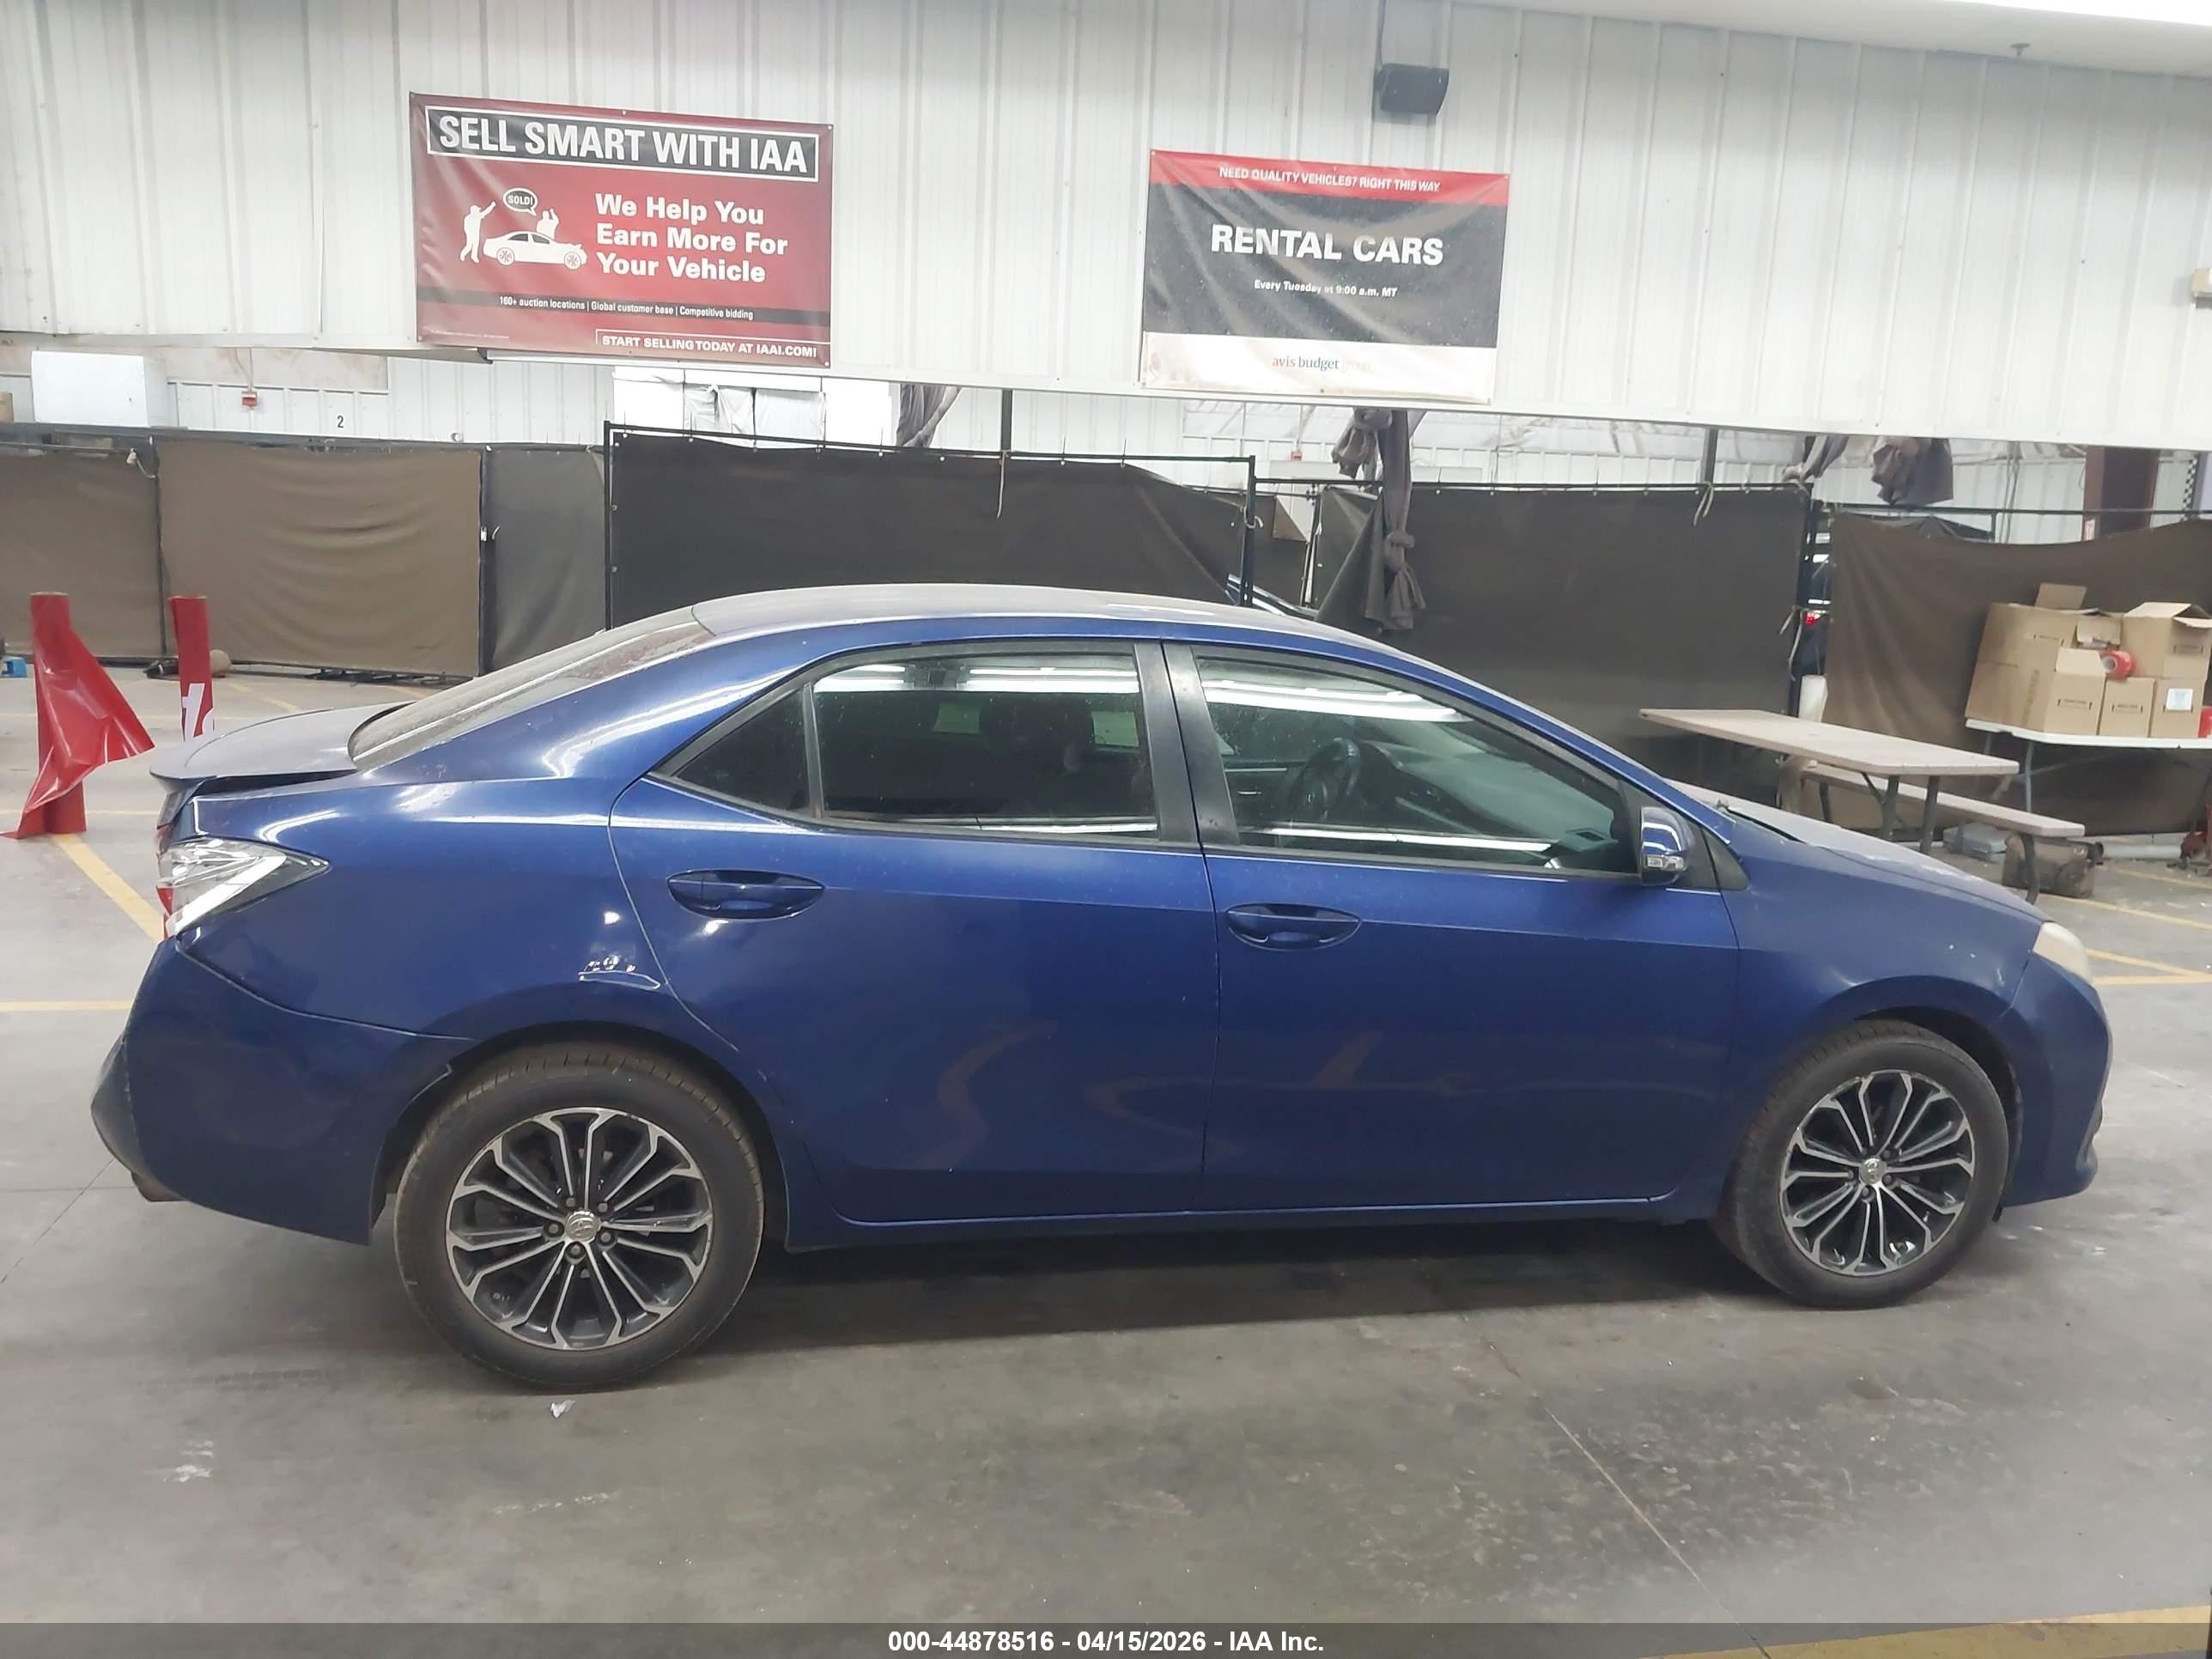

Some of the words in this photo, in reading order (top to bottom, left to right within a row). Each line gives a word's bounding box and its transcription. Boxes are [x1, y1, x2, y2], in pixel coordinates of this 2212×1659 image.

[440, 115, 517, 153] SELL
[524, 121, 646, 162] SMART
[652, 131, 740, 169] WITH
[750, 137, 808, 173] IAA
[1218, 166, 1249, 179] NEED
[1251, 168, 1300, 183] QUALITY
[1300, 173, 1357, 187] VEHICLES?
[1359, 176, 1392, 190] RIGHT
[1394, 178, 1417, 191] THIS
[507, 194, 533, 207] SOLD!
[594, 192, 638, 217] We
[646, 196, 708, 226] Help
[714, 200, 765, 226] You
[596, 222, 659, 248] Earn
[666, 226, 737, 252] More
[744, 231, 789, 256] For
[1210, 223, 1342, 260] RENTAL
[1352, 234, 1444, 266] CARS
[595, 251, 659, 276] Your
[665, 255, 767, 283] Vehicle
[1254, 278, 1281, 293] Every
[1283, 280, 1322, 295] Tuesday
[1358, 287, 1380, 297] a.m.
[1381, 286, 1398, 298] MT
[519, 297, 549, 308] auction
[550, 298, 586, 310] locations
[591, 301, 616, 312] Global
[617, 303, 653, 314] customer
[654, 304, 674, 315] base
[679, 305, 724, 319] Competitive
[725, 307, 754, 321] bidding
[602, 335, 641, 348] START
[643, 336, 695, 350] SELLING
[696, 339, 736, 353] TODAY
[738, 341, 753, 354] AT
[1272, 355, 1297, 368] avis
[1297, 356, 1340, 372] budget
[337, 415, 344, 428] 2
